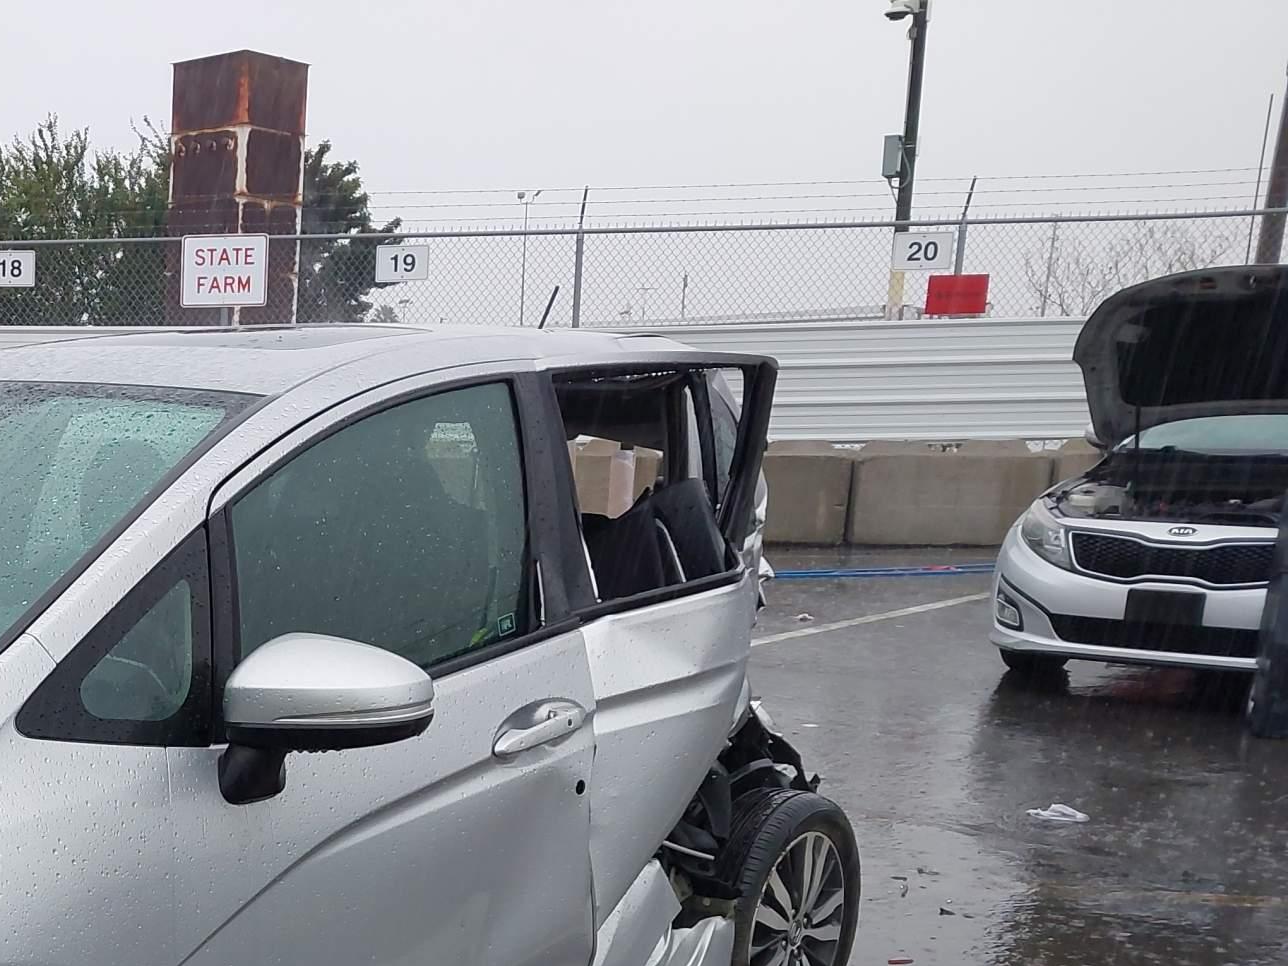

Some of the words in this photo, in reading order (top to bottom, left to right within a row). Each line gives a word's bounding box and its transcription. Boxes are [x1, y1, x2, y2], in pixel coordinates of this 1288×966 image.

[195, 248, 255, 266] STATE
[907, 241, 938, 261] 20
[390, 253, 416, 272] 19
[196, 275, 251, 294] FARM
